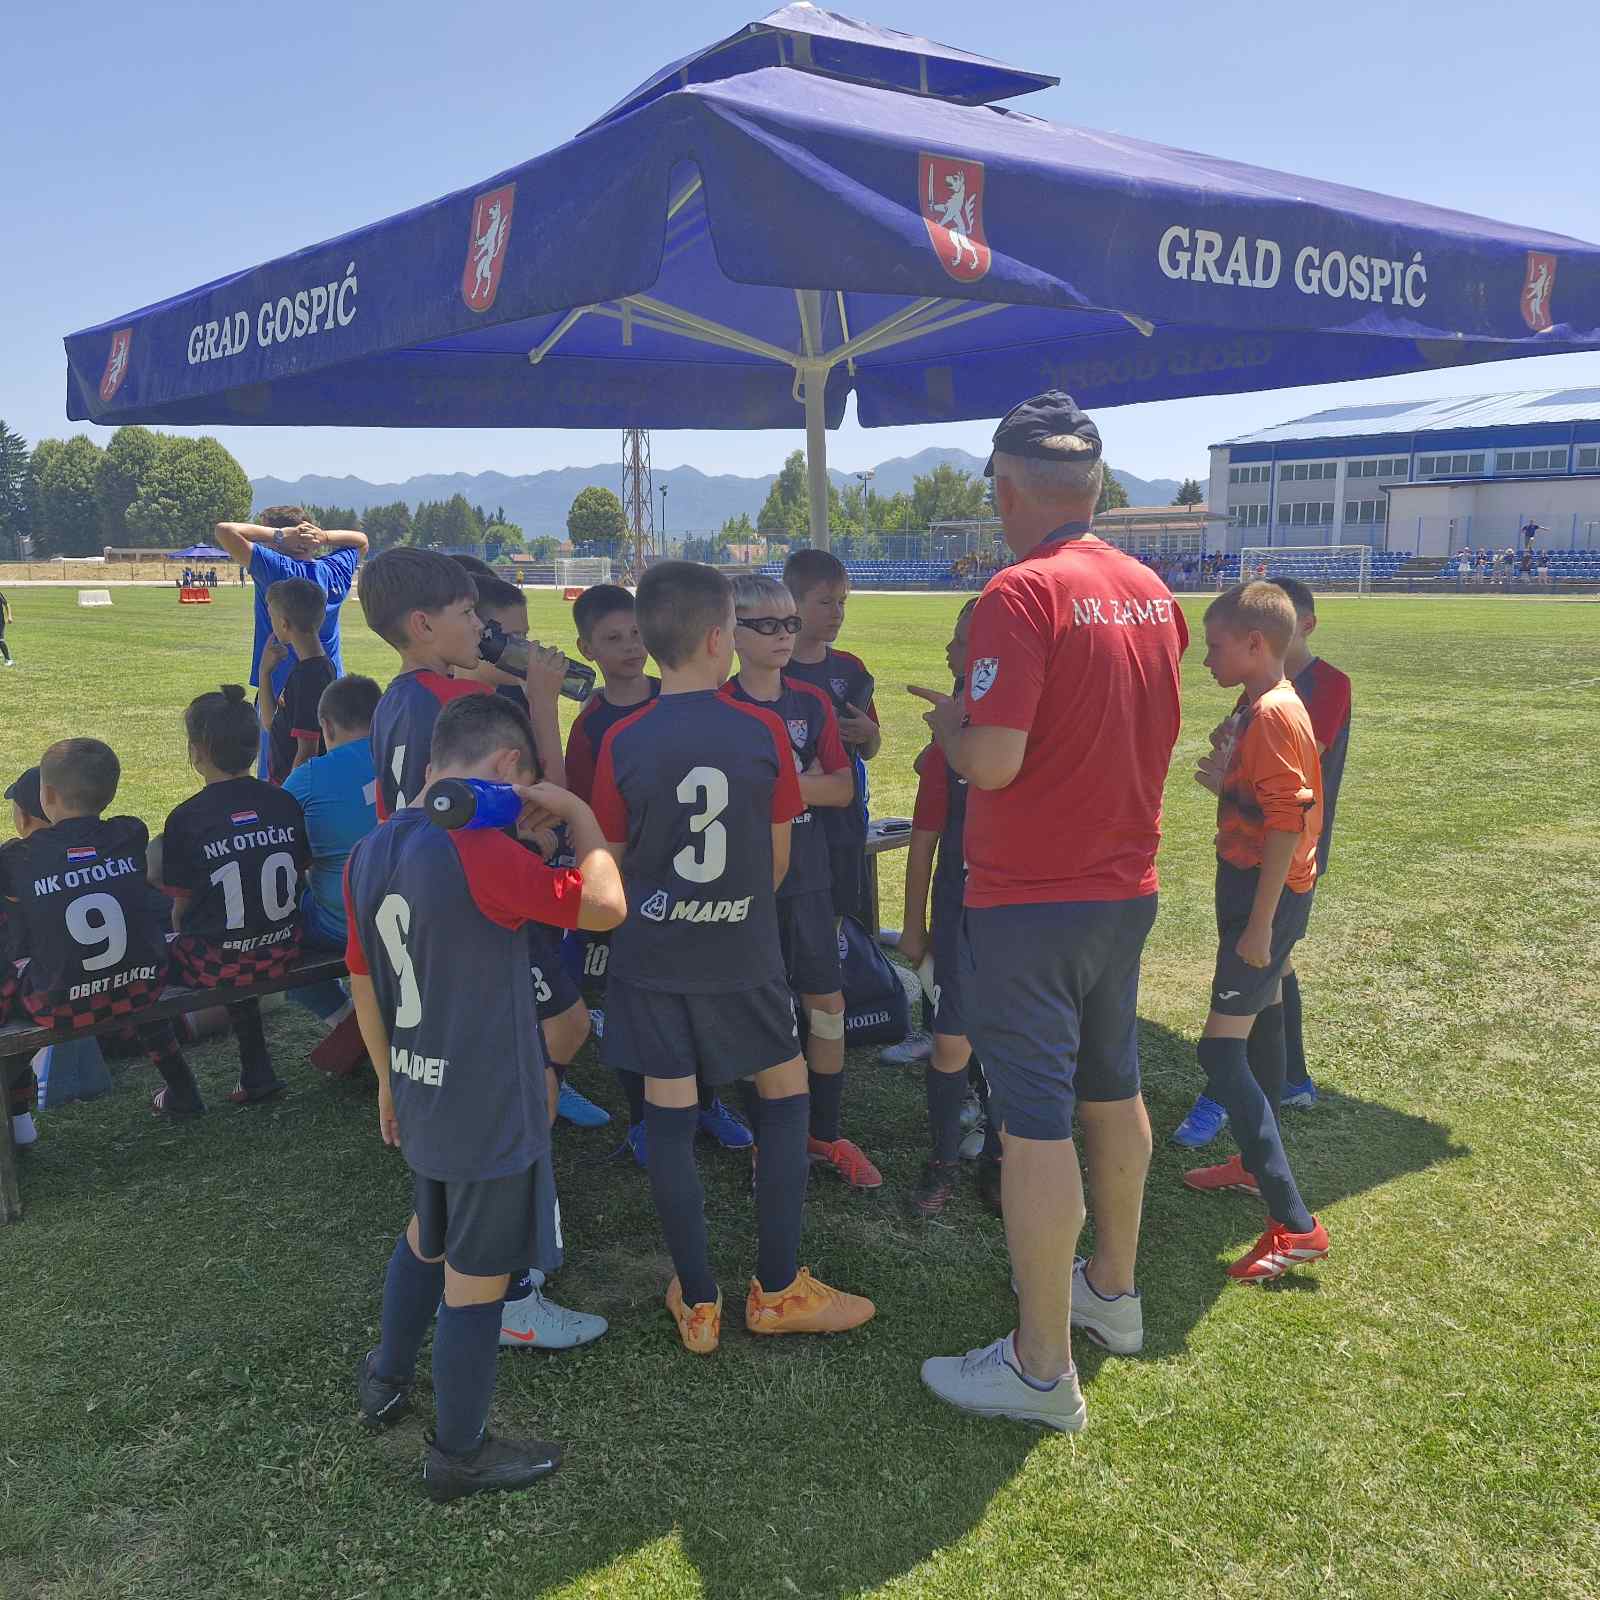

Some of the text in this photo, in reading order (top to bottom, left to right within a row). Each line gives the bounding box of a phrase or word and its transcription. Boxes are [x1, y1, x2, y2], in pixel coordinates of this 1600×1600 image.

[1158, 225, 1427, 308] GRAD GOSPIĆ
[187, 261, 357, 365] GRAD GOSPIĆ
[1072, 598, 1174, 625] NK ZAMET
[203, 825, 295, 859] NK OTOČAC
[673, 766, 729, 883] 3
[34, 874, 61, 896] NK
[210, 851, 298, 930] 10
[669, 898, 750, 923] MAPEI
[65, 892, 128, 971] 9
[584, 942, 609, 976] 10
